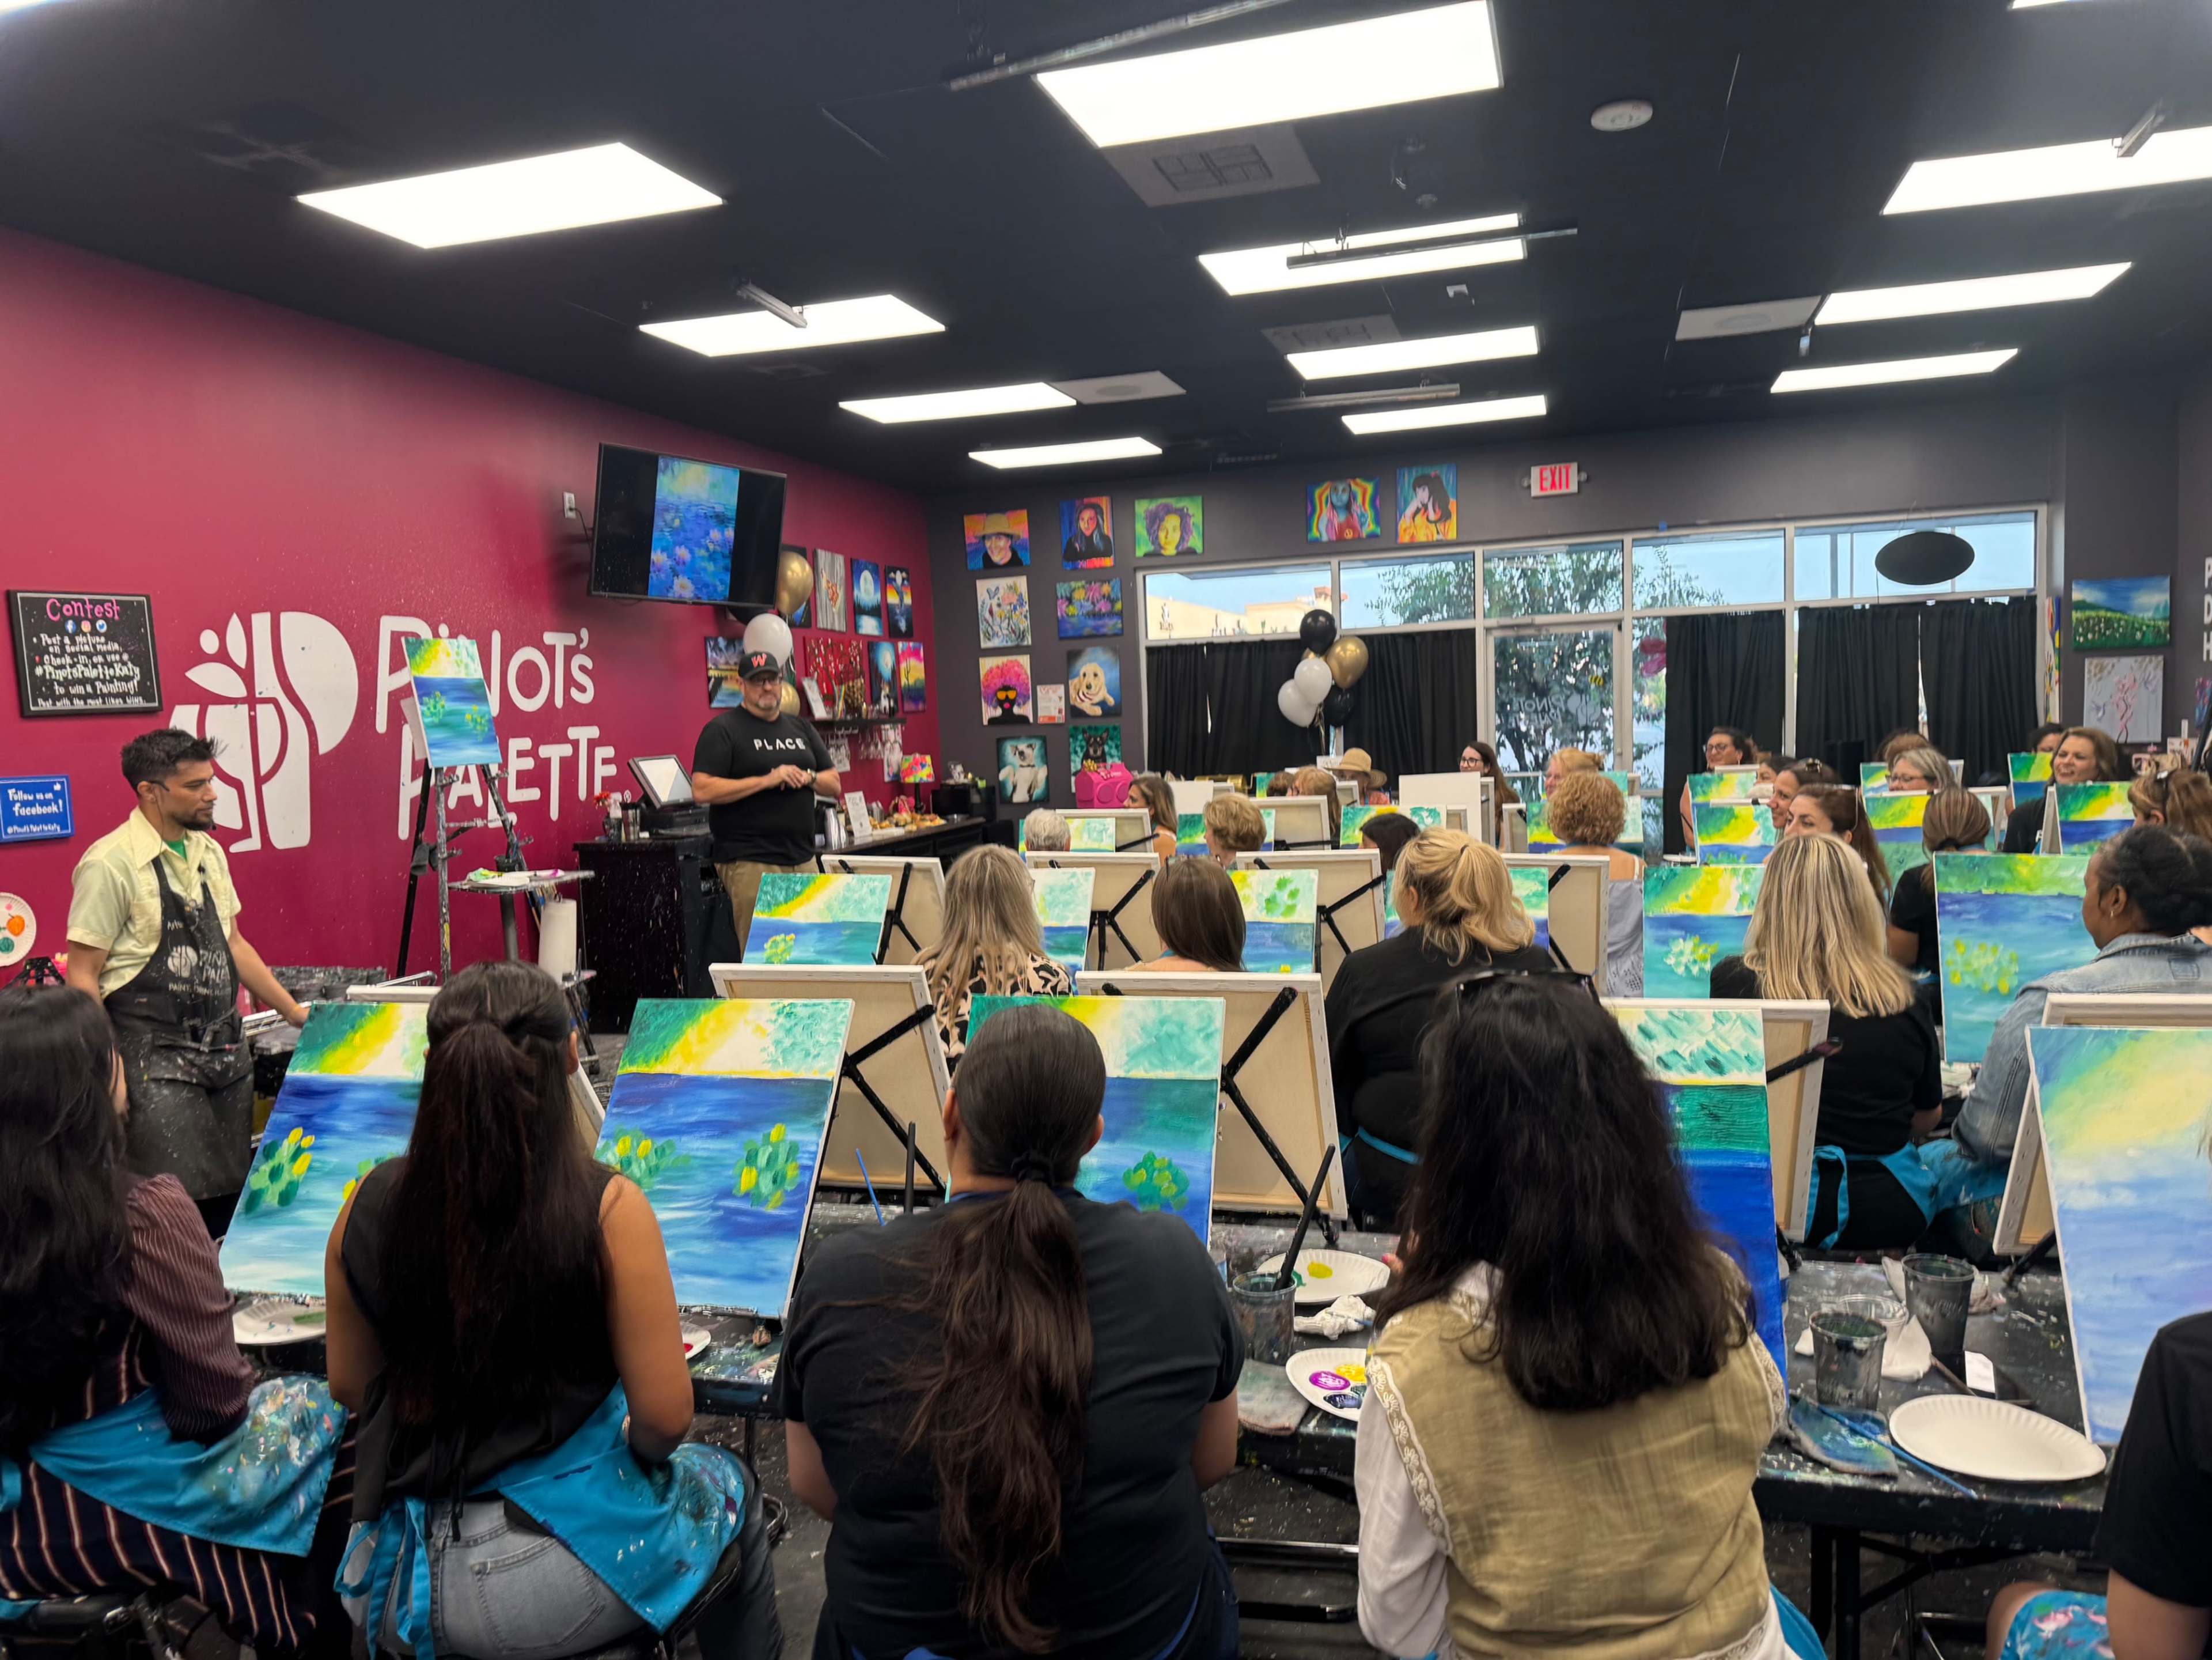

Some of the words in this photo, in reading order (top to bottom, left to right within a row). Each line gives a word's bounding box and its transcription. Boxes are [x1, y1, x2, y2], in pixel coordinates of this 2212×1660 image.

[1539, 464, 1571, 492] EXIT
[46, 598, 120, 621] Contest
[751, 653, 767, 668] W
[376, 615, 594, 733] POT'S
[69, 684, 85, 694] win
[753, 738, 805, 750] PLACE
[7, 788, 33, 801] Follow
[13, 799, 63, 816] facebook!
